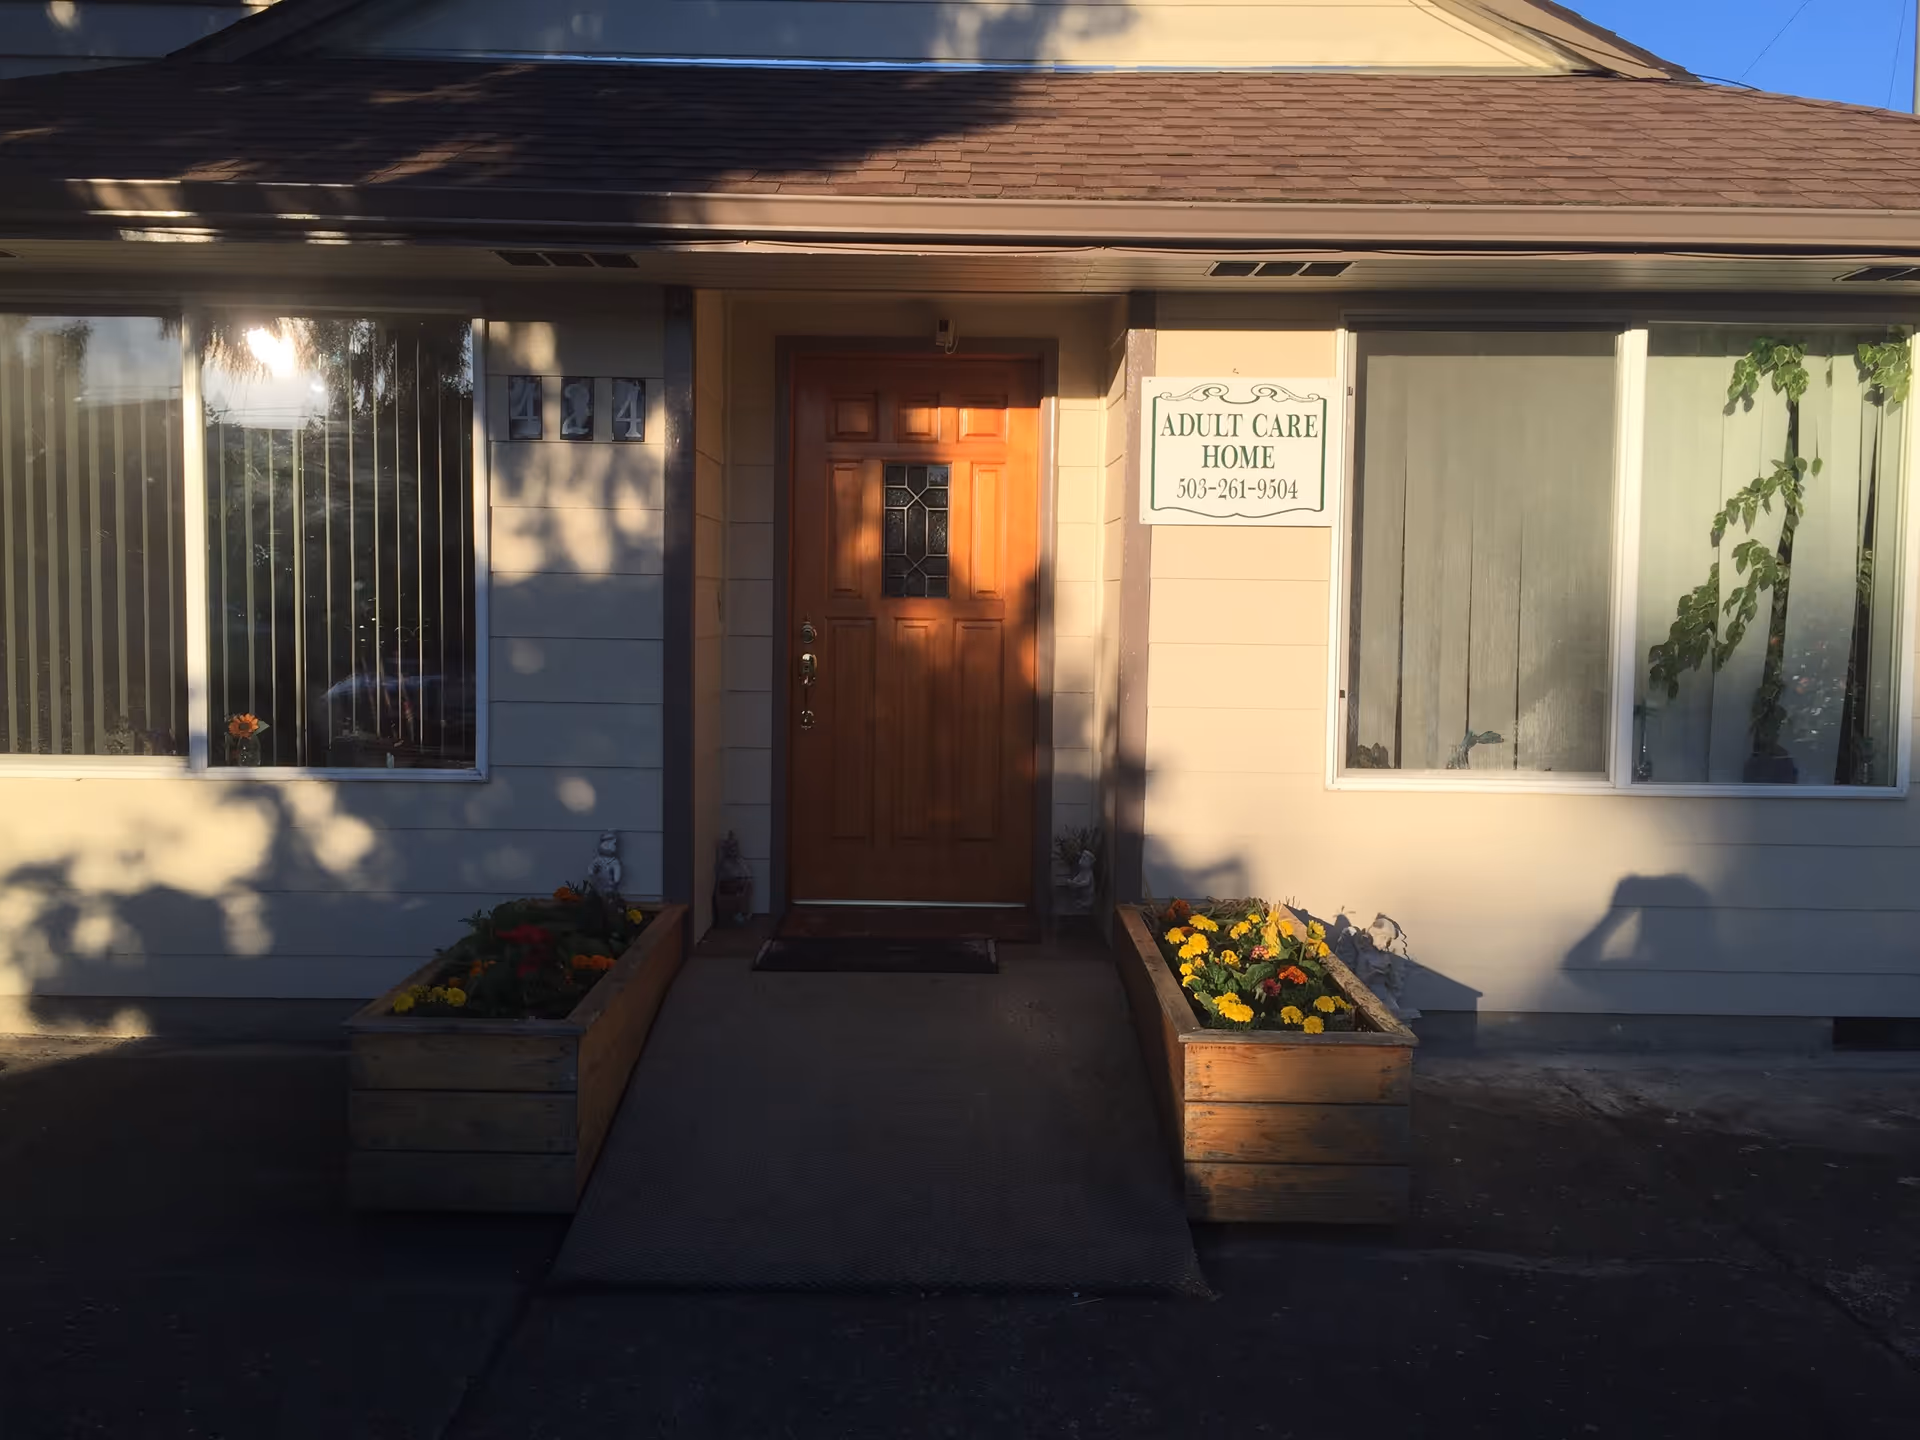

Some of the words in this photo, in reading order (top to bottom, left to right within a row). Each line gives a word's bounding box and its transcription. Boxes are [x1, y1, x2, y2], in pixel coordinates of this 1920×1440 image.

[1160, 412, 1243, 437] ADULT
[1252, 413, 1319, 438] CARE
[1201, 444, 1275, 469] HOME
[1176, 478, 1298, 500] 503-261-9504
